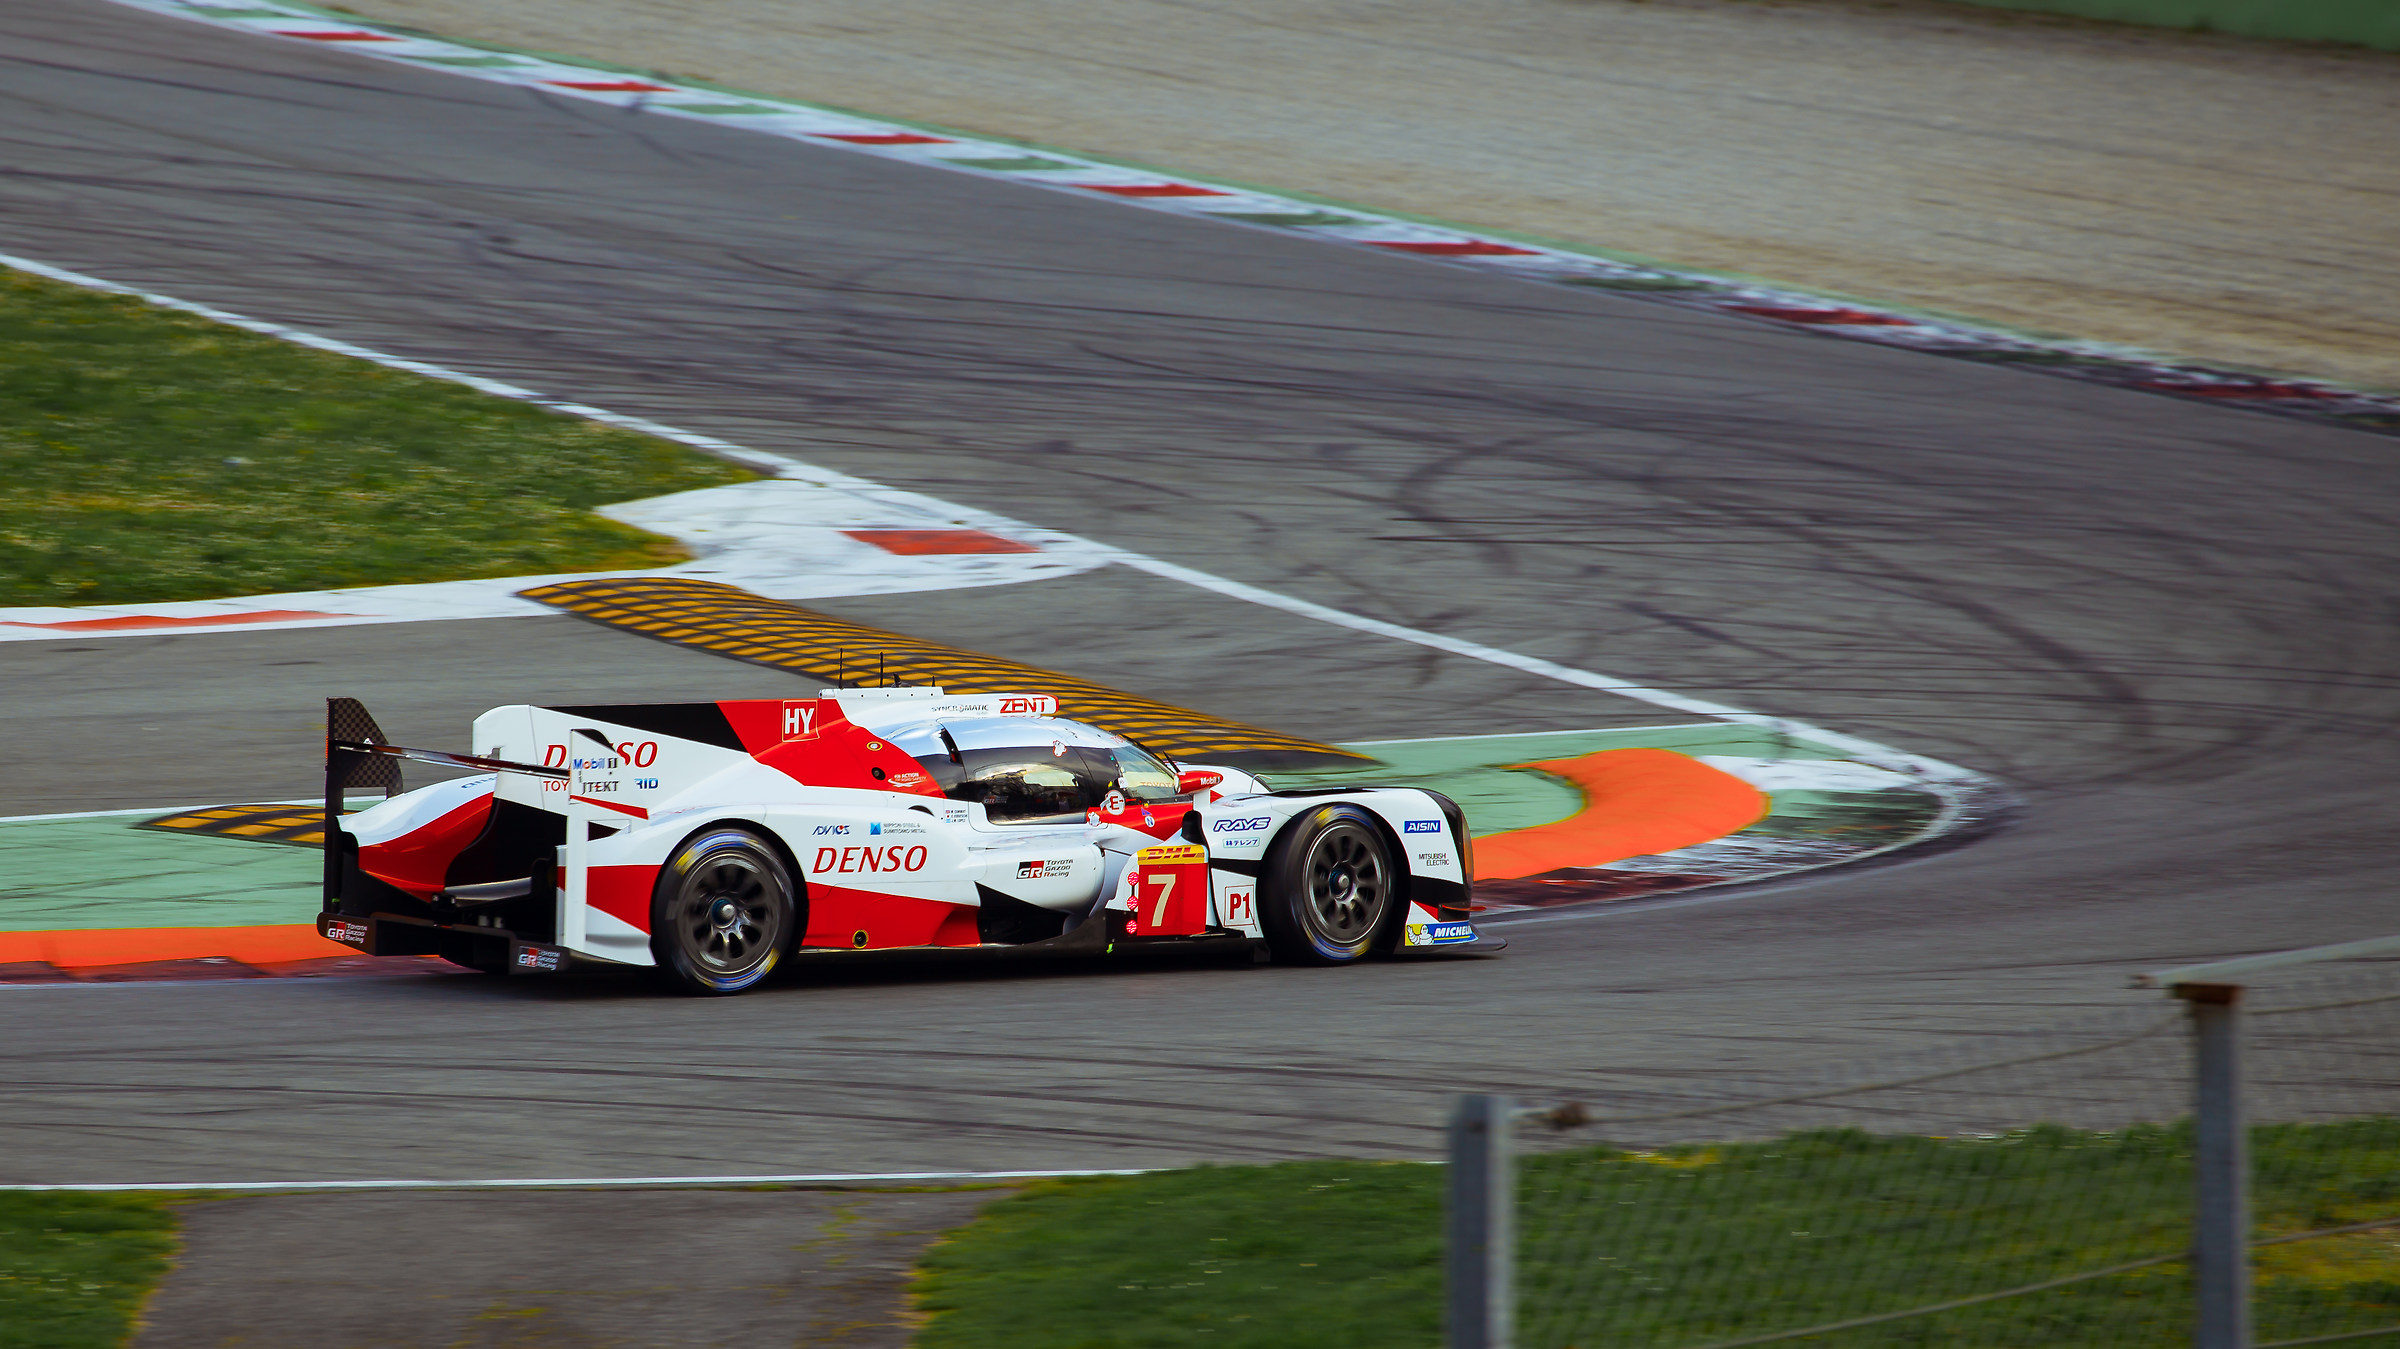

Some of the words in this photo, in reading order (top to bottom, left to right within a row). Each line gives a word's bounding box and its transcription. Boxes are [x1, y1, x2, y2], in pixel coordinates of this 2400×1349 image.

[999, 697, 1048, 713] ZENT
[785, 708, 815, 734] HY
[543, 741, 659, 769] DSO
[573, 758, 605, 770] Mobil
[581, 781, 619, 795] JTEKT
[1213, 817, 1271, 832] RAYS
[1407, 822, 1439, 832] AISIN
[812, 845, 927, 873] DENSO
[1146, 847, 1197, 860] DHL
[1018, 867, 1043, 878] GR
[1148, 874, 1176, 927] 7
[1230, 892, 1250, 920] P1
[327, 928, 345, 939] GR
[518, 953, 538, 966] GR
